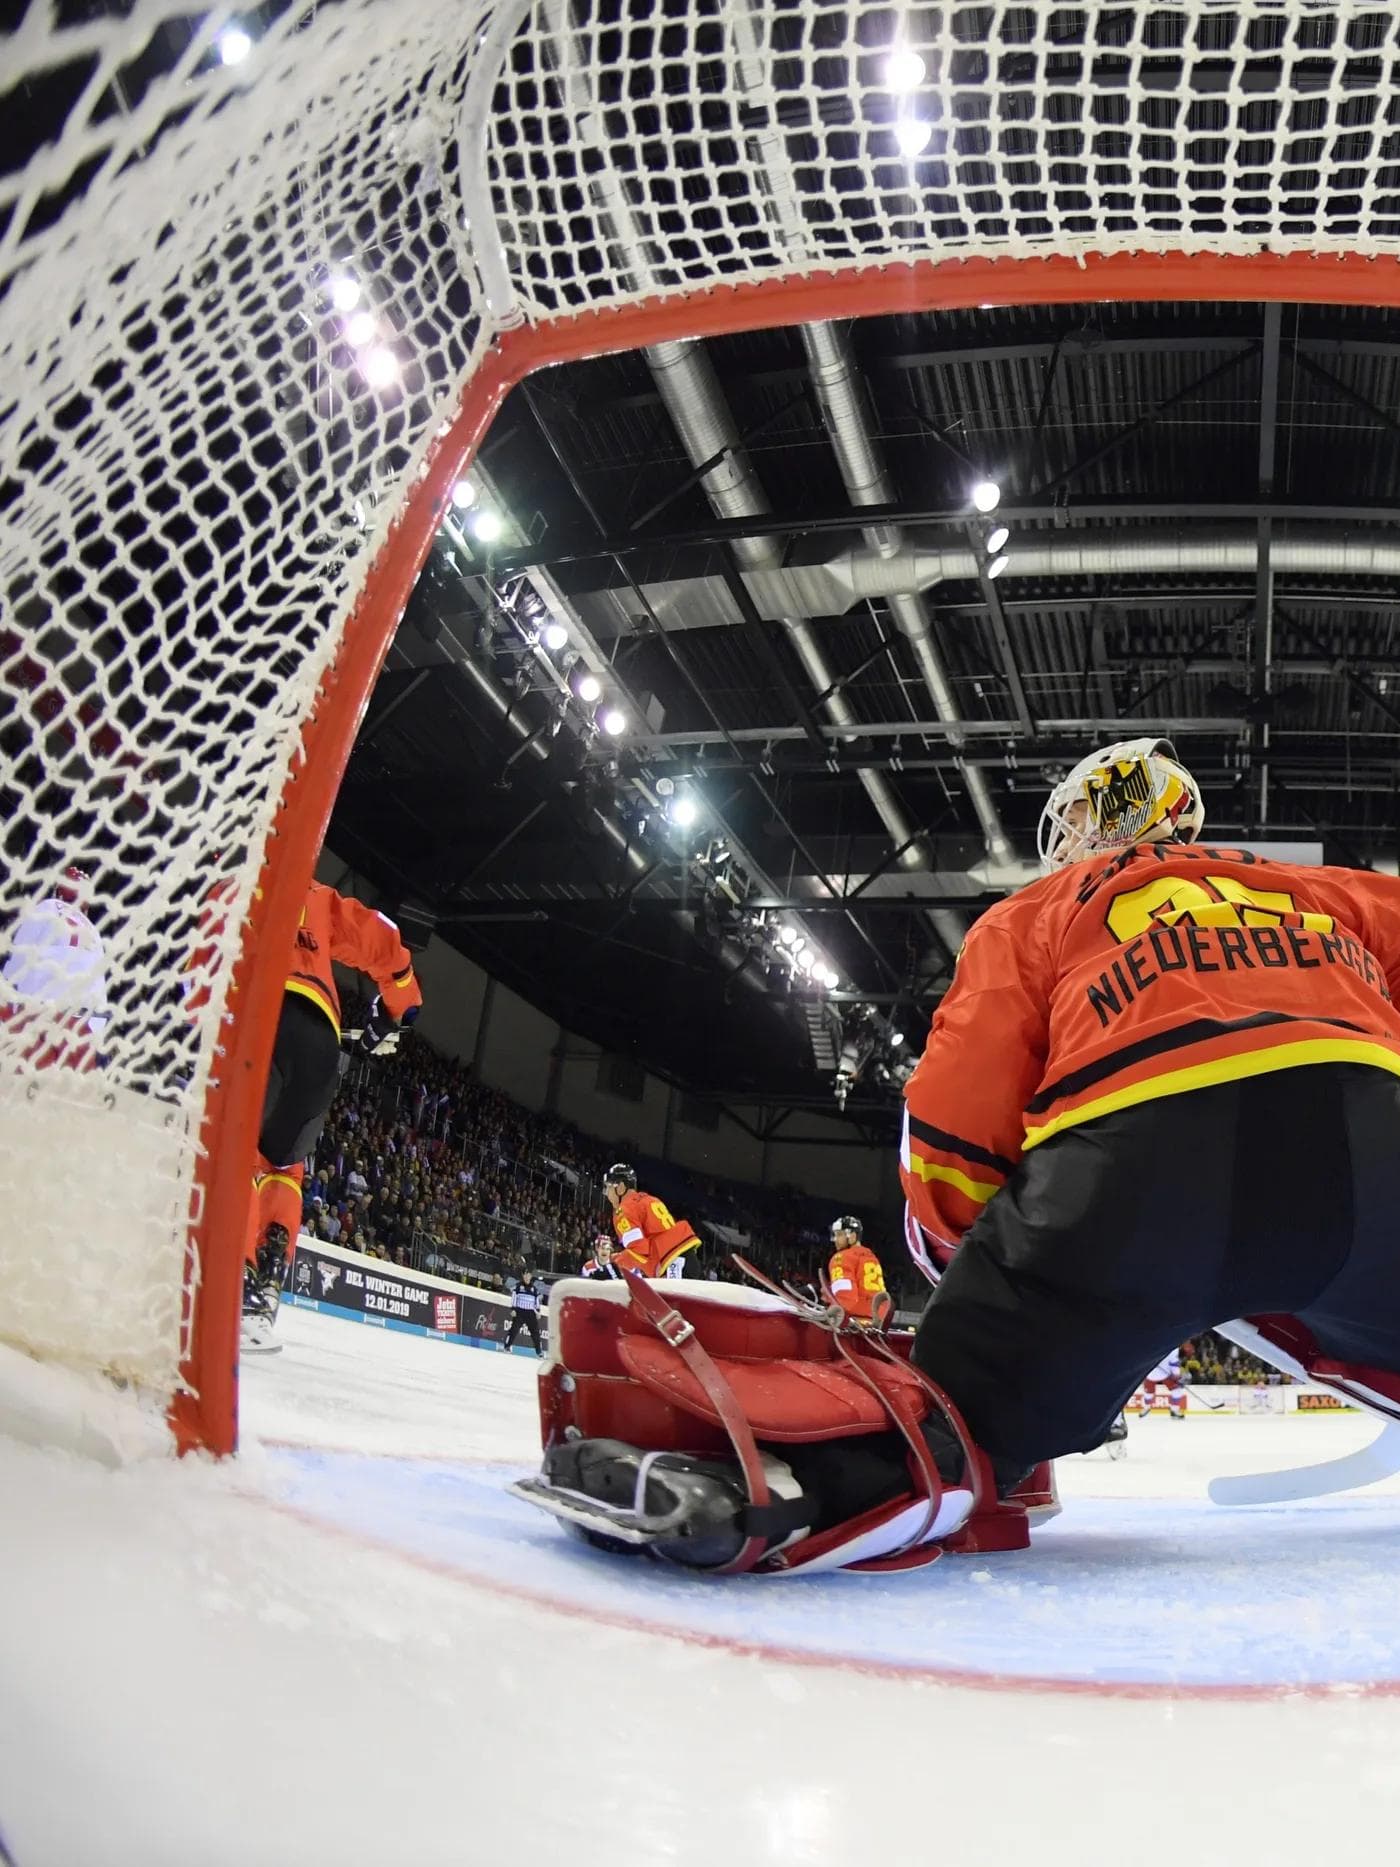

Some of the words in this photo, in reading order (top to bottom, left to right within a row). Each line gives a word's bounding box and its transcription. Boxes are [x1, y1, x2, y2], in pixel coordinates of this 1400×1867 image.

[345, 1270, 364, 1288] DEL
[365, 1275, 403, 1297] WINTER
[403, 1286, 429, 1305] GAME
[364, 1293, 410, 1317] 12.01.2019
